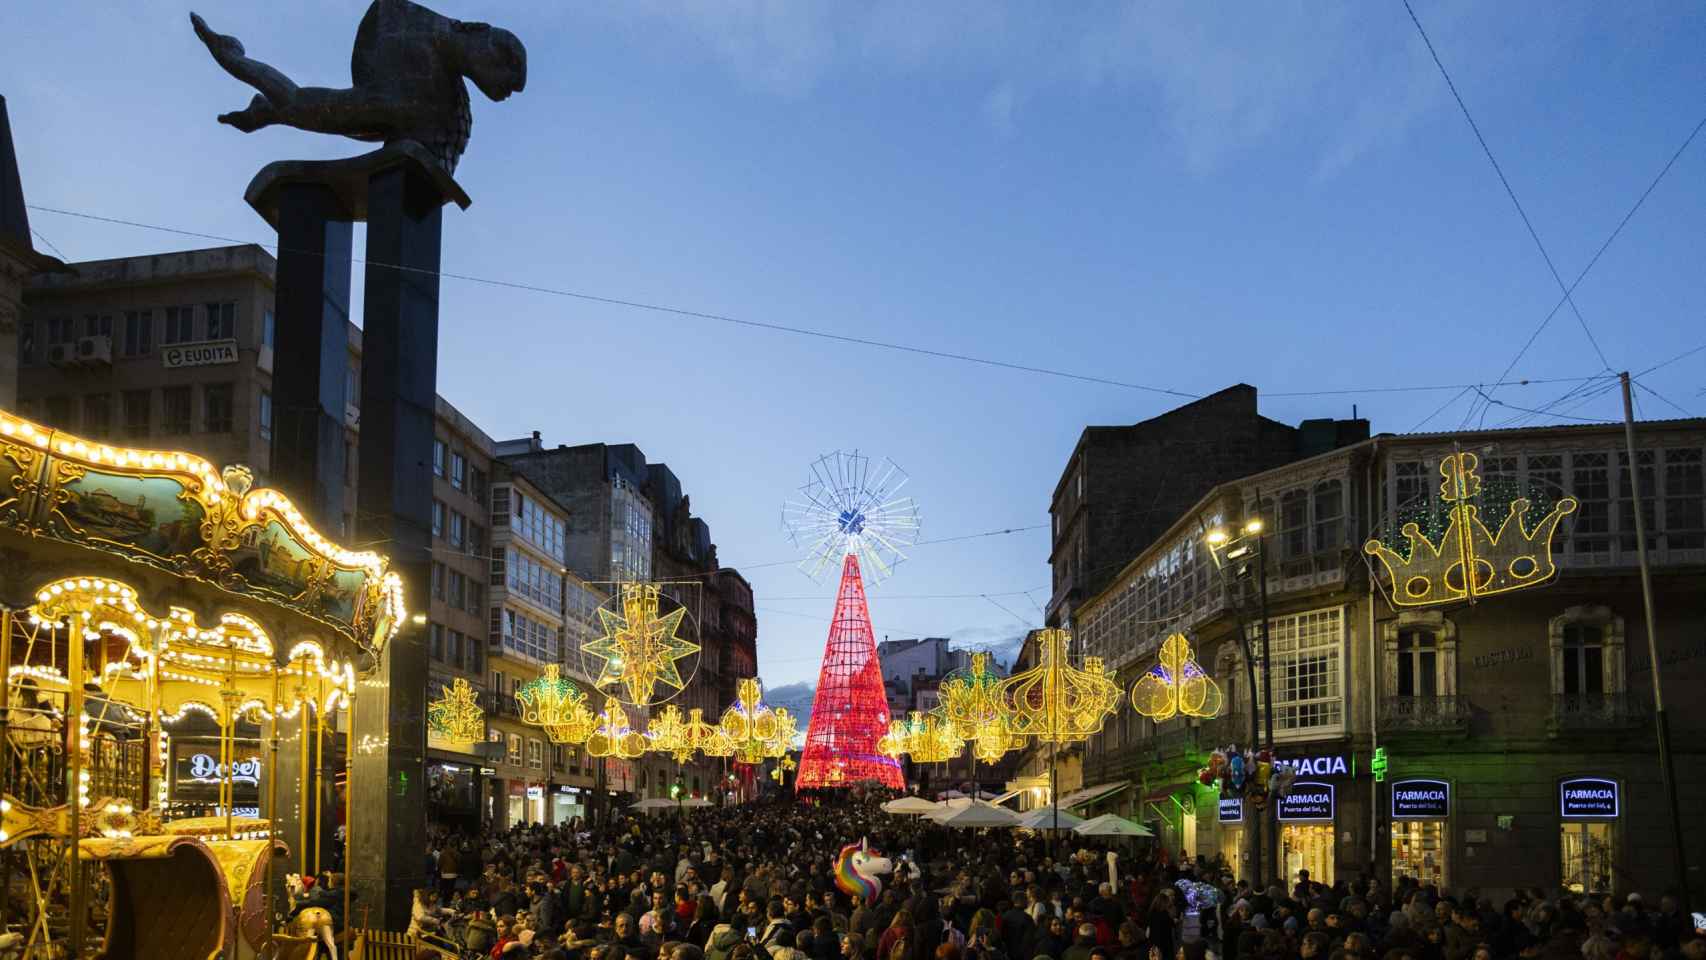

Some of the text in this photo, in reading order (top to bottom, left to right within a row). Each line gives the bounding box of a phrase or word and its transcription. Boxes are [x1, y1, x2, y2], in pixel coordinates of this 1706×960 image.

[185, 347, 233, 361] EUDITA
[1280, 793, 1330, 804] ARMACIA
[1396, 791, 1445, 800] FARMACIA
[1565, 790, 1613, 799] FARMACIA
